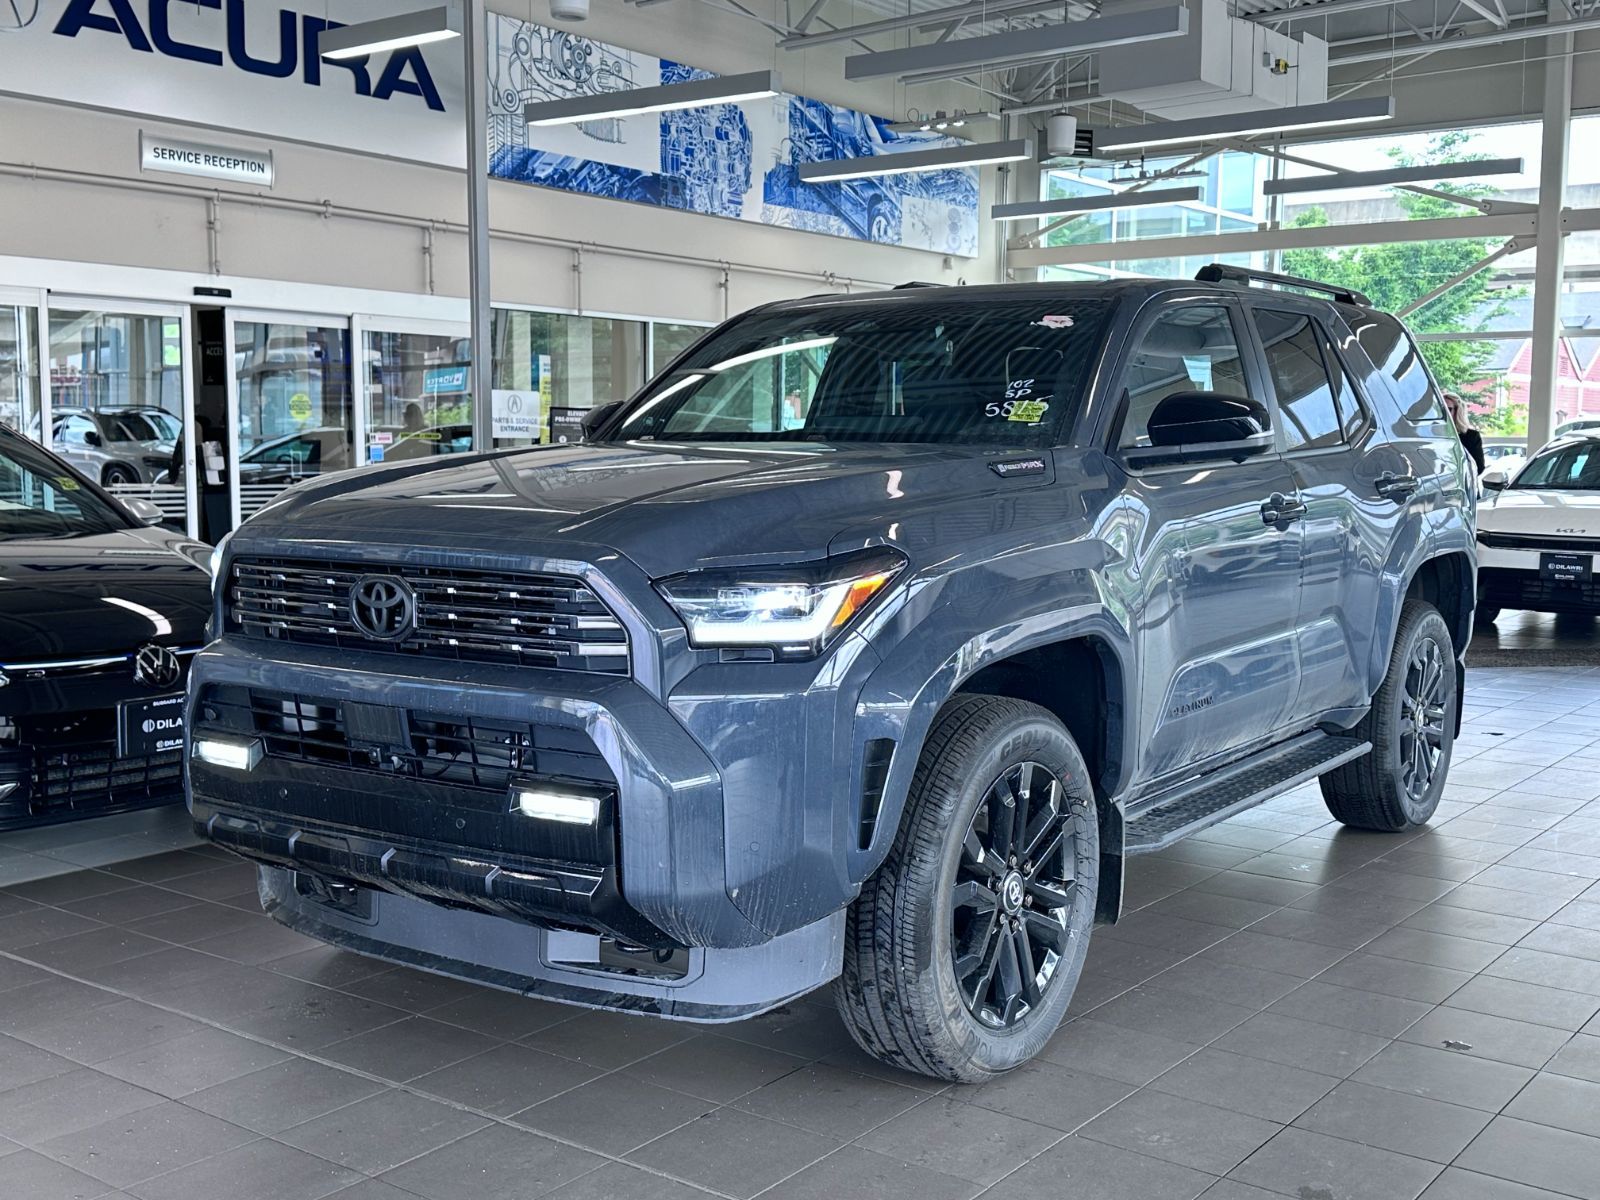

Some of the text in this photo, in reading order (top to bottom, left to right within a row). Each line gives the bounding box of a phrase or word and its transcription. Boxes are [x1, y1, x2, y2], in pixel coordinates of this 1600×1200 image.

[52, 0, 446, 112] ACURA
[153, 147, 265, 173] SERVICE RECEPTION
[500, 425, 530, 433] ENTRANCE
[516, 417, 538, 425] SERVICE
